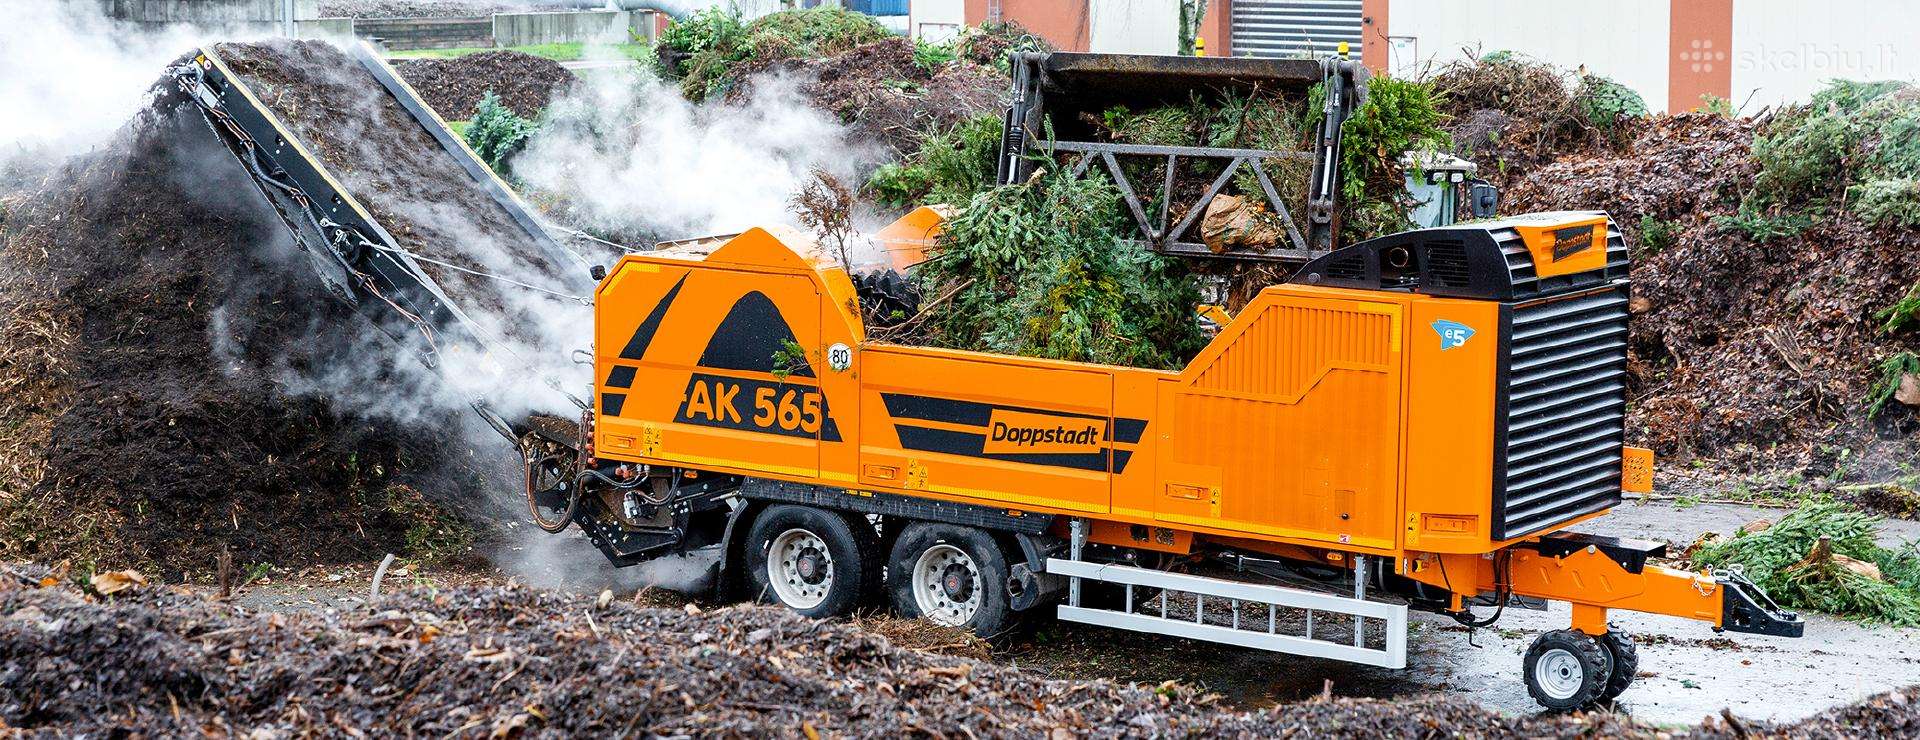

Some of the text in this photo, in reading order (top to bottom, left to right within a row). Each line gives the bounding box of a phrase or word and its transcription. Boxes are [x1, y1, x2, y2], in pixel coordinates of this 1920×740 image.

[1444, 329, 1466, 346] e5
[832, 349, 848, 364] 80
[686, 380, 823, 433] AK 565
[992, 421, 1098, 446] Doppstadt
